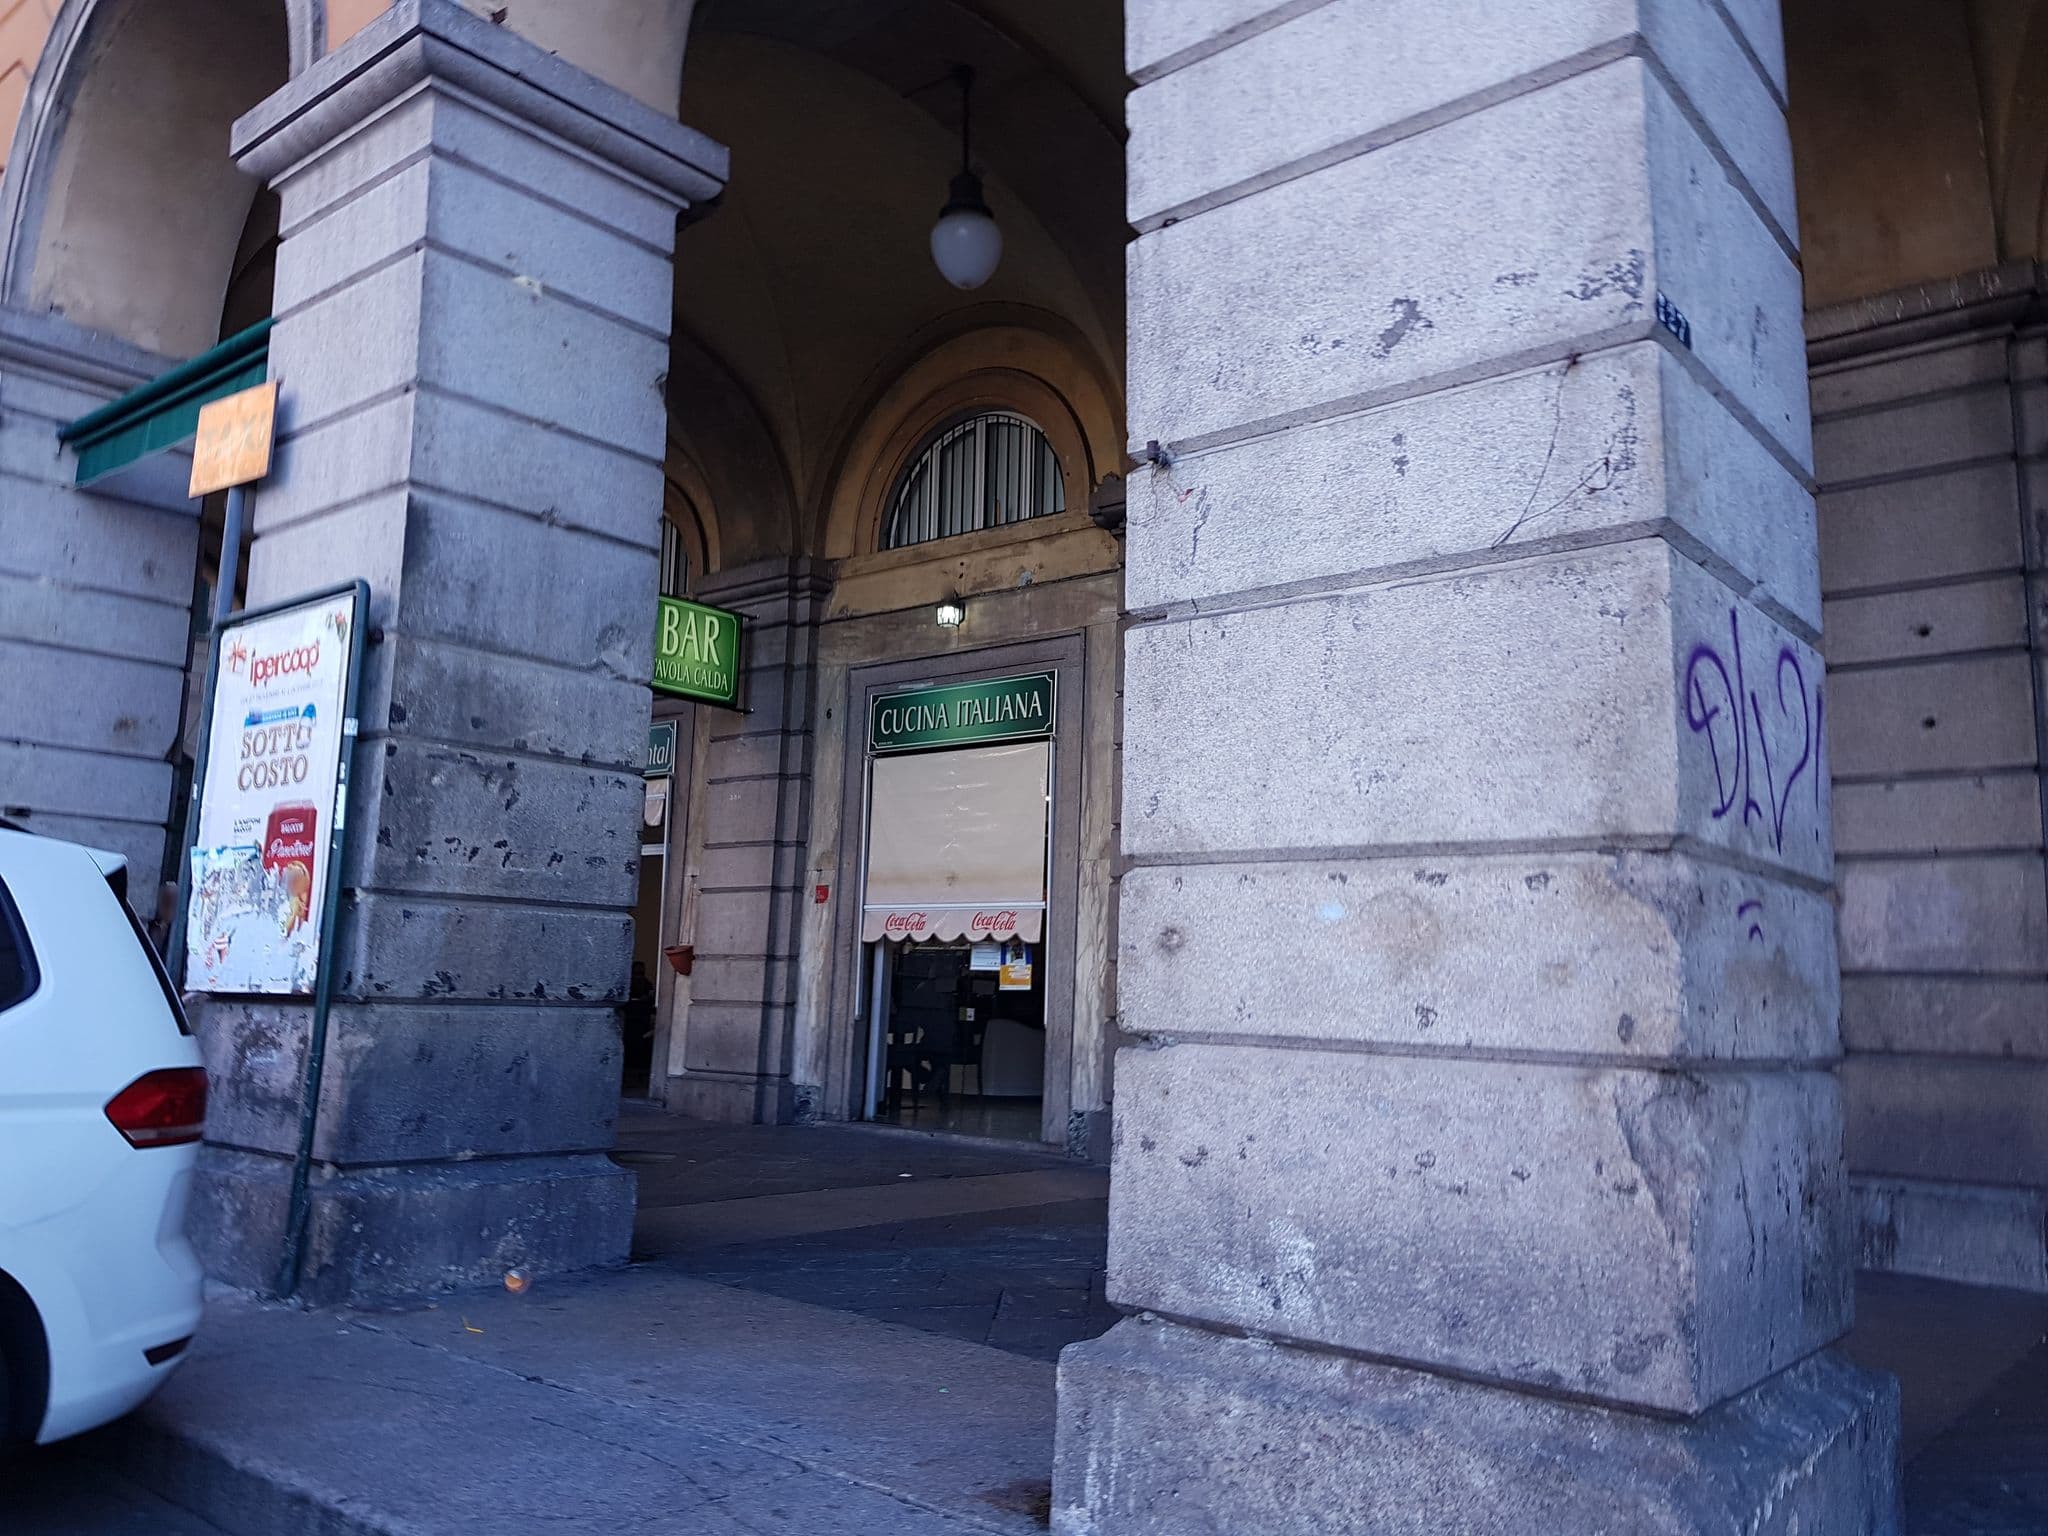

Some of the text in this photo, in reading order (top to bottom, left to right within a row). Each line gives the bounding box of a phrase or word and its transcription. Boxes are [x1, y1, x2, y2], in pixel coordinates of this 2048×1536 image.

[662, 604, 720, 666] BAR
[249, 637, 320, 688] ipercoop
[655, 657, 728, 692] AVOLA CALDA
[880, 690, 1043, 735] CUCINA ITALIANA
[241, 722, 312, 759] SOTTO
[238, 754, 308, 791] COSTO
